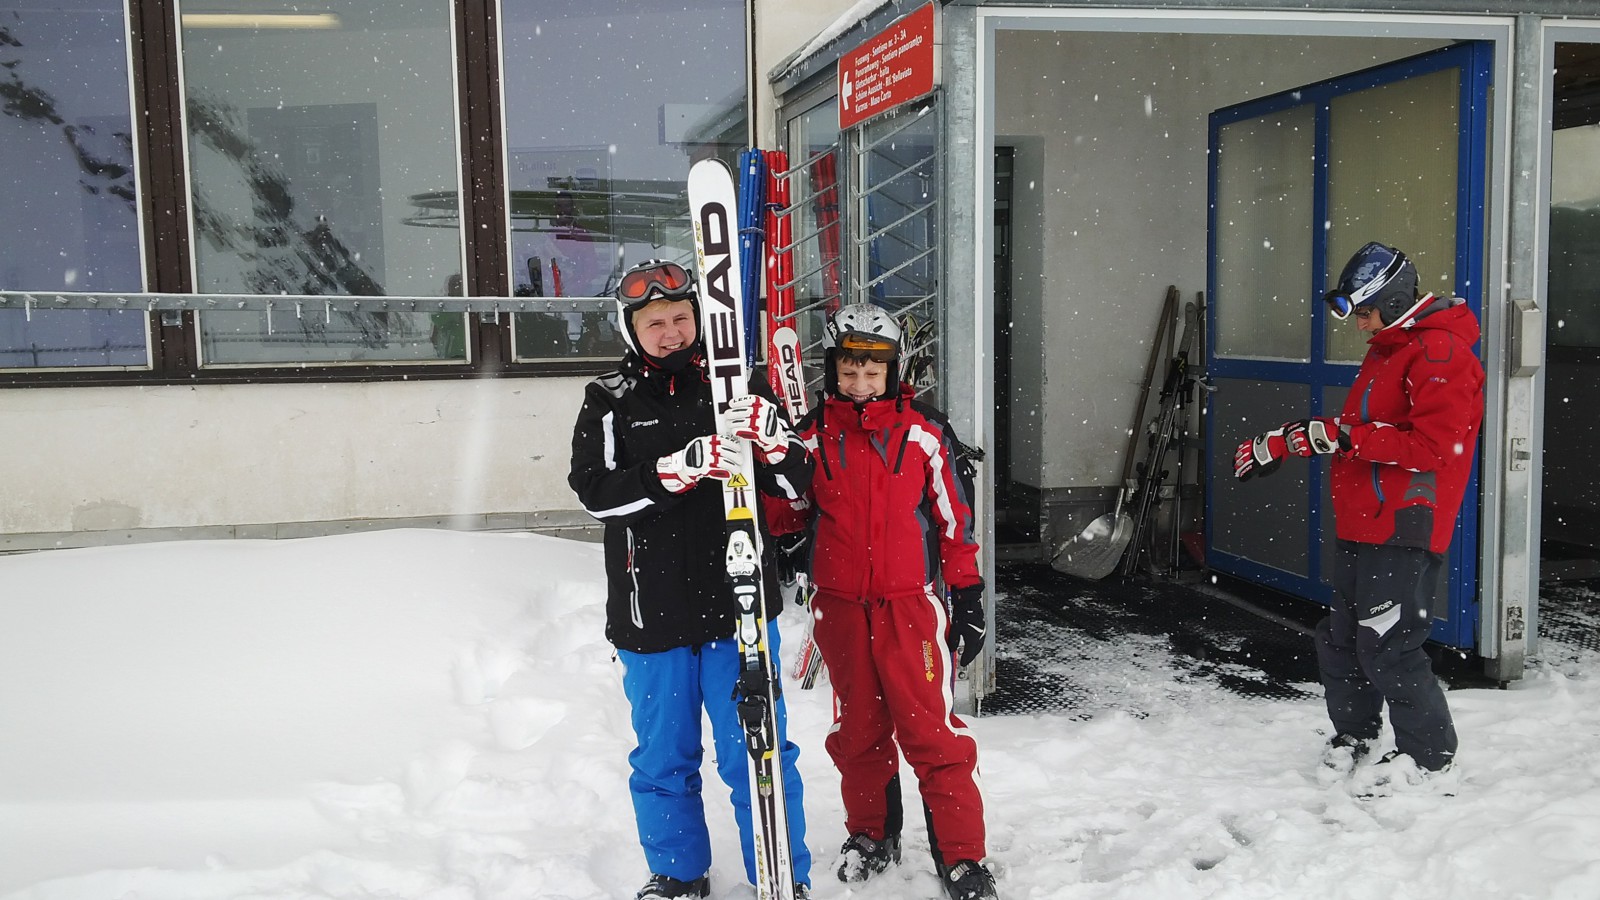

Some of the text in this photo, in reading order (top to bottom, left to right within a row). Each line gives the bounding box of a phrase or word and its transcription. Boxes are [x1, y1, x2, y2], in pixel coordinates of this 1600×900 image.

[872, 43, 887, 57] Sentiero
[894, 33, 897, 44] 3
[900, 29, 906, 40] 3A
[881, 49, 897, 64] Sentiero
[898, 35, 922, 57] panoramico
[868, 81, 882, 95] Aussicht
[870, 96, 880, 106] Maso
[881, 90, 891, 101] Corto
[700, 201, 742, 414] HEAD
[781, 344, 805, 420] HEAD
[733, 396, 752, 404] LEKI
[1369, 599, 1394, 615] SPYDER
